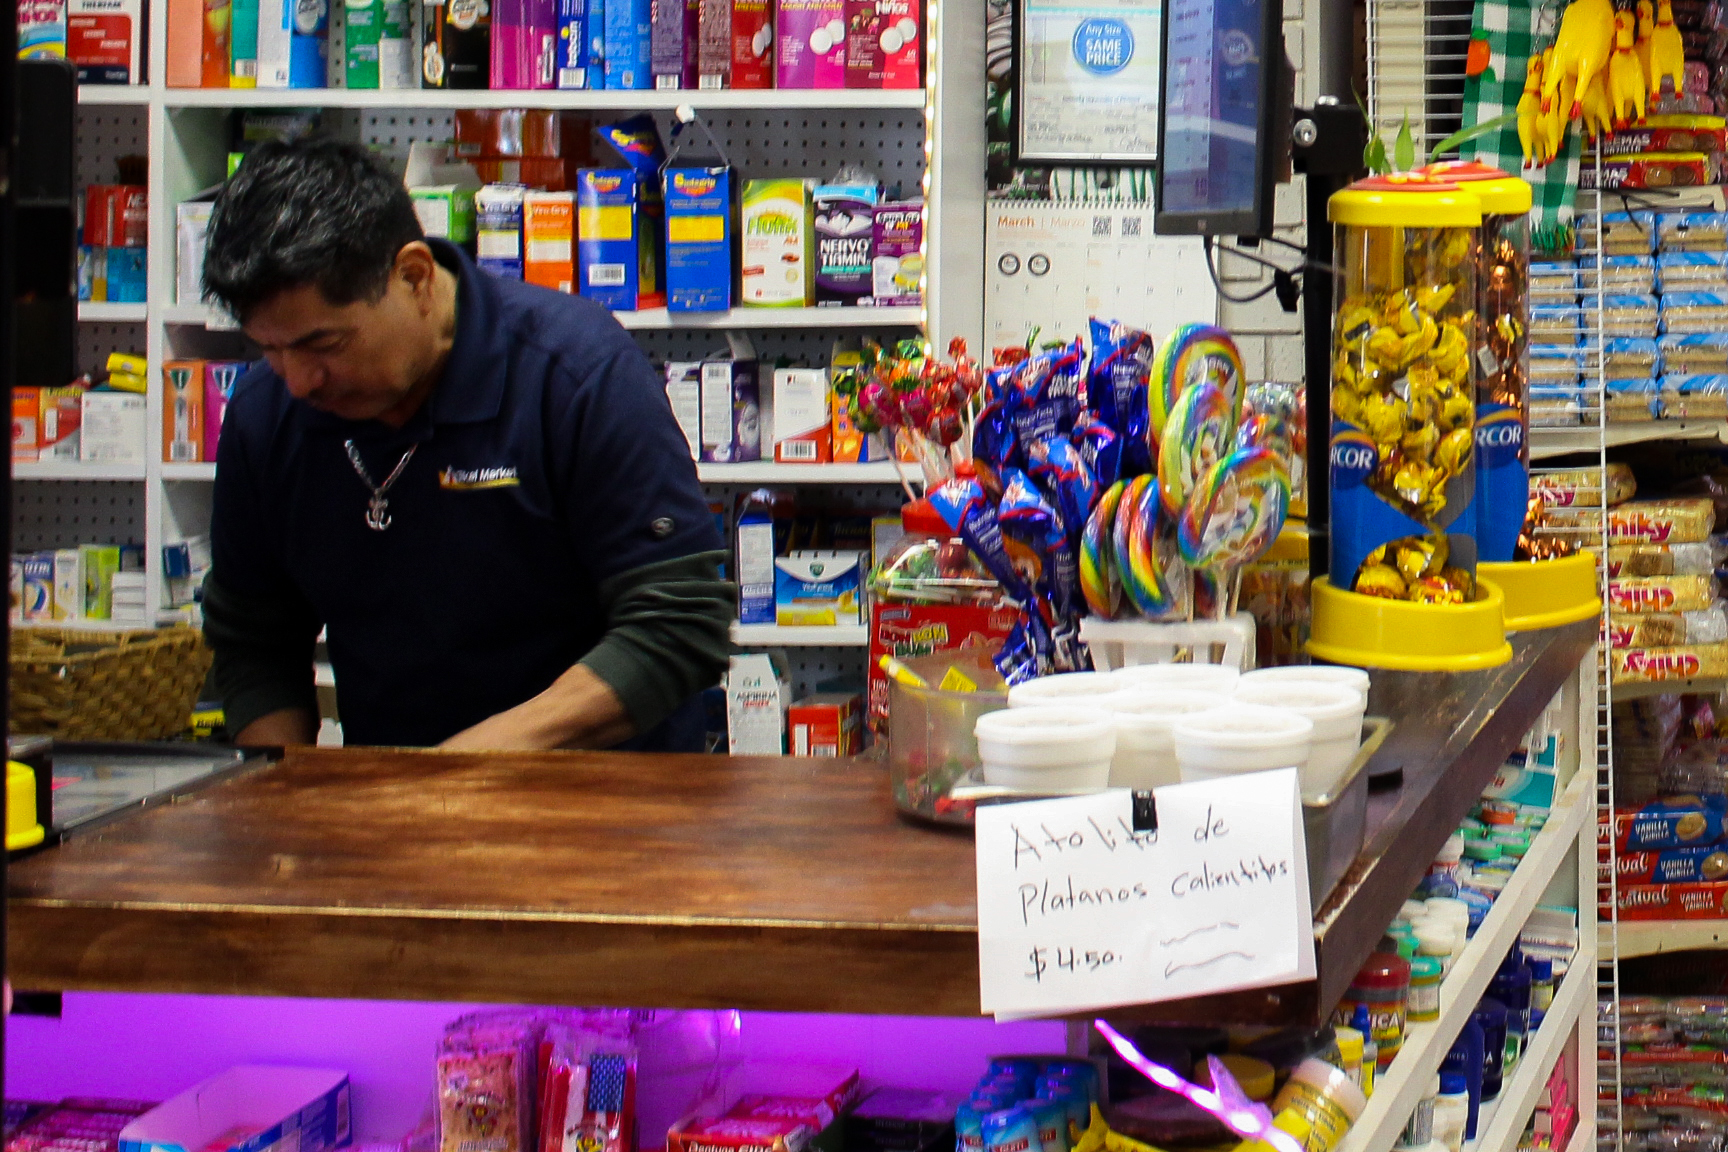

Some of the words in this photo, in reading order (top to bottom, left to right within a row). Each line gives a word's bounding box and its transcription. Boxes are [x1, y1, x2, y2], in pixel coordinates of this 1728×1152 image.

[1086, 38, 1121, 52] SAME
[1086, 51, 1121, 66] PRICE
[997, 215, 1035, 228] March
[820, 238, 869, 254] NERVO
[1474, 424, 1522, 448] RCOR
[1330, 446, 1374, 471] RCOR
[1193, 803, 1230, 845] de
[1018, 875, 1148, 927] Platanos
